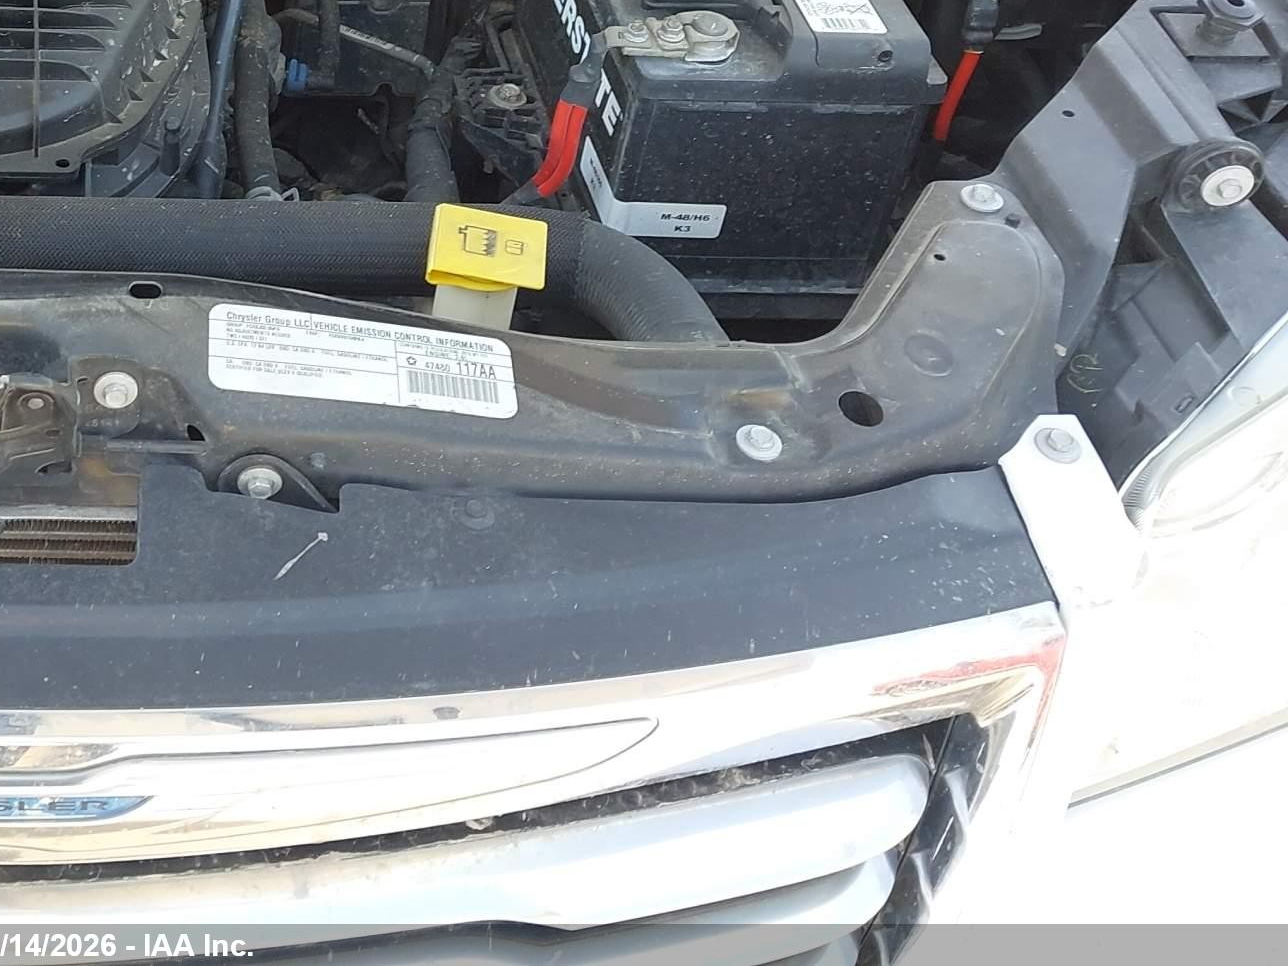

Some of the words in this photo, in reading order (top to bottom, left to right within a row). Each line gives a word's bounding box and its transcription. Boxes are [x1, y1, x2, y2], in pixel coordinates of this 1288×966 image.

[674, 225, 691, 233] K3
[226, 311, 262, 323] Chrysler
[265, 315, 291, 327] Group
[294, 319, 309, 328] LLC
[313, 321, 349, 333] VEHICLE
[351, 325, 392, 338] EMISSION
[394, 332, 432, 344] CONTROL
[436, 338, 493, 352] INFORMATION
[456, 362, 497, 379] 117AA
